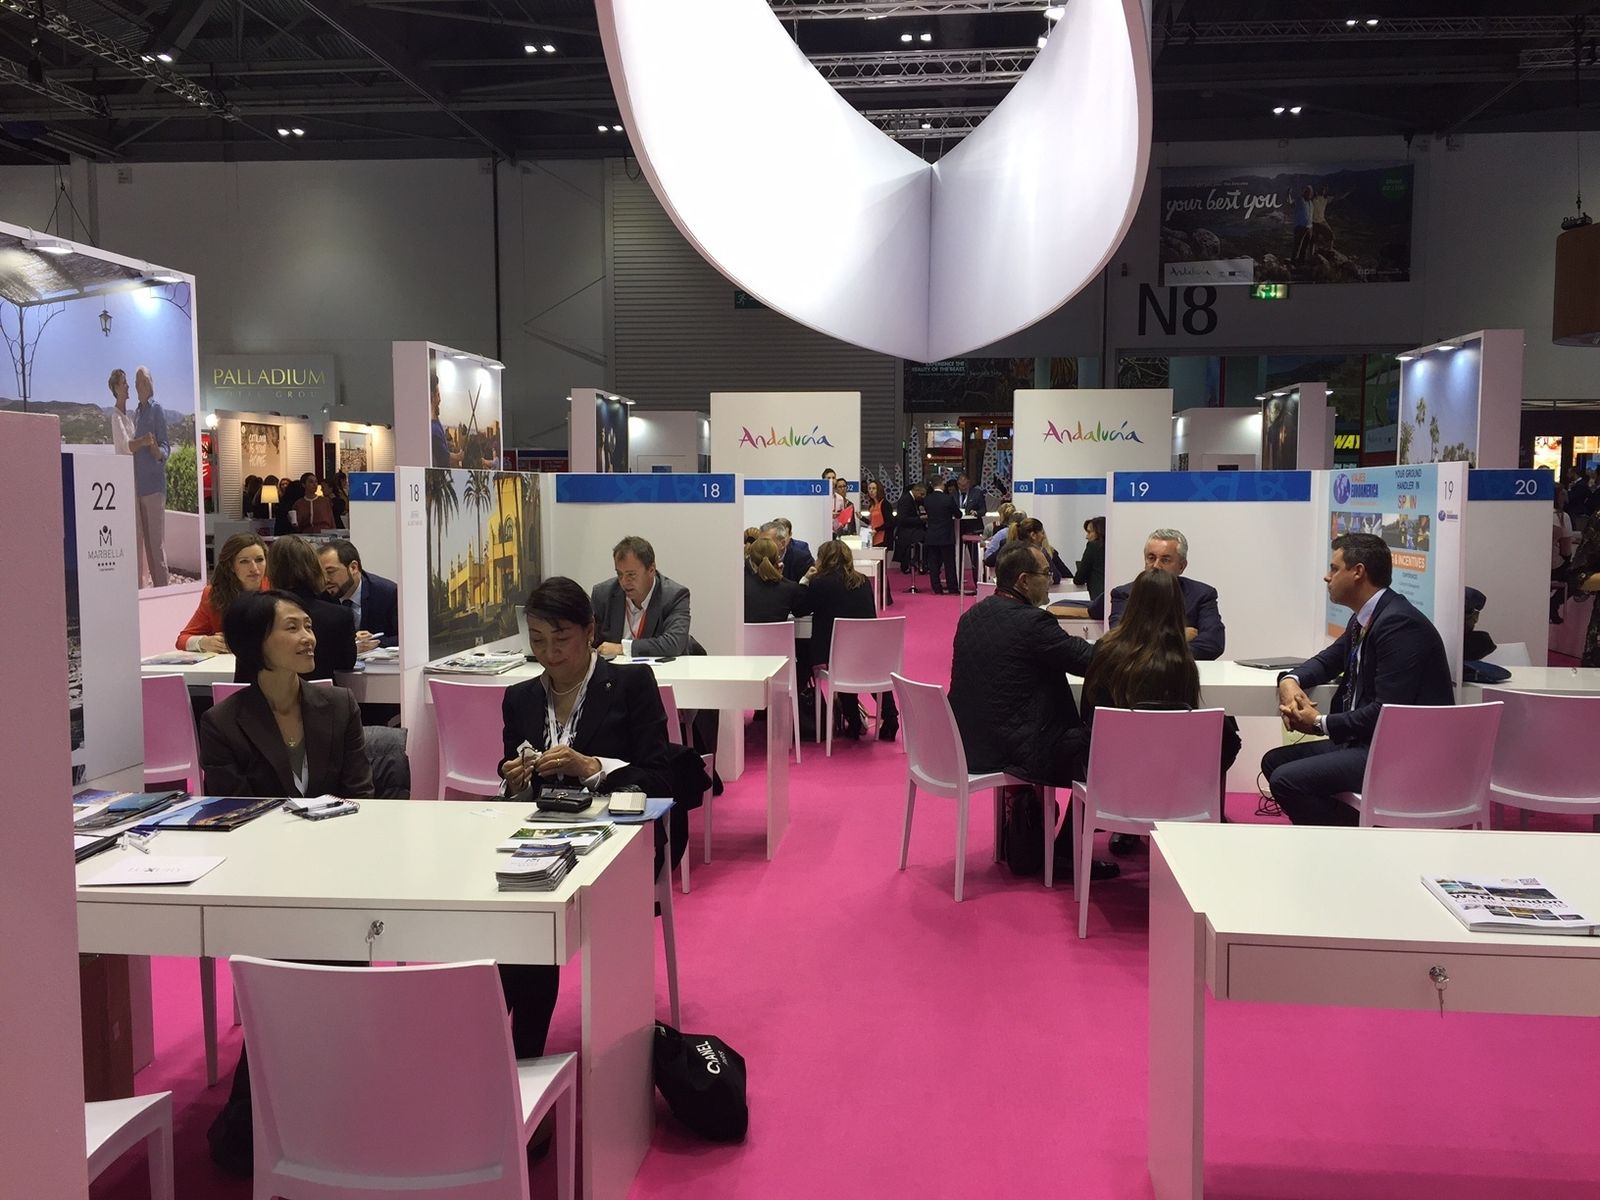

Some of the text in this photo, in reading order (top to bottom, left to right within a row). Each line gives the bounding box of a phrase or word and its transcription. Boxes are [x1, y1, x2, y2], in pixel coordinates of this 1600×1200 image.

[1165, 189, 1284, 222] your best you
[1138, 283, 1218, 336] N8
[213, 368, 325, 385] PALLADIUM
[275, 391, 320, 399] GROU
[738, 425, 834, 449] Andalucía
[1043, 420, 1144, 444] Andalucía
[363, 482, 381, 497] 17
[409, 484, 420, 502] 18
[702, 482, 721, 498] 18
[810, 484, 822, 494] 10
[1019, 484, 1029, 492] 03
[1044, 483, 1054, 493] 11
[1129, 481, 1150, 497] 19
[1444, 481, 1454, 500] 19
[1515, 479, 1538, 495] 20
[91, 482, 116, 511] 22
[87, 548, 124, 560] MARBELLA
[1500, 896, 1564, 905] London
